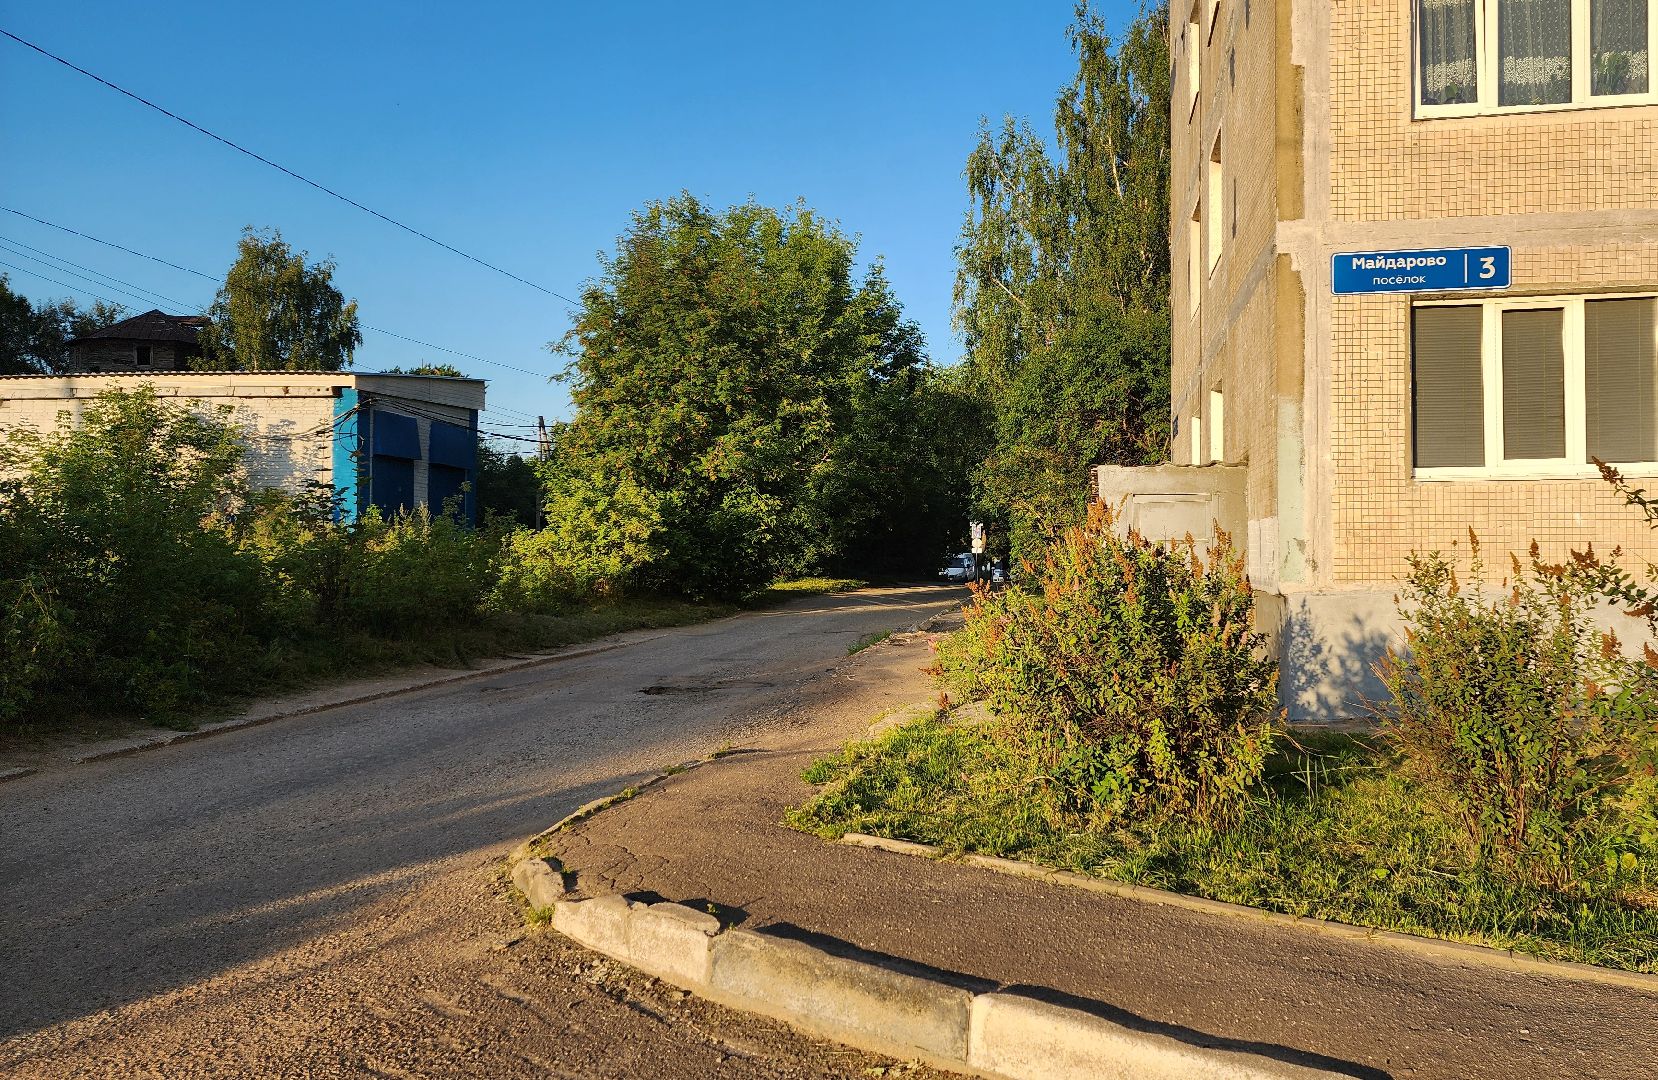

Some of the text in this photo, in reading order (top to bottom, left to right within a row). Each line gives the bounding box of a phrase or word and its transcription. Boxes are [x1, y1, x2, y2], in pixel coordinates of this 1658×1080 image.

[1352, 256, 1447, 271] Майдарово
[1479, 257, 1496, 279] 3
[1373, 274, 1426, 285] посёлок
